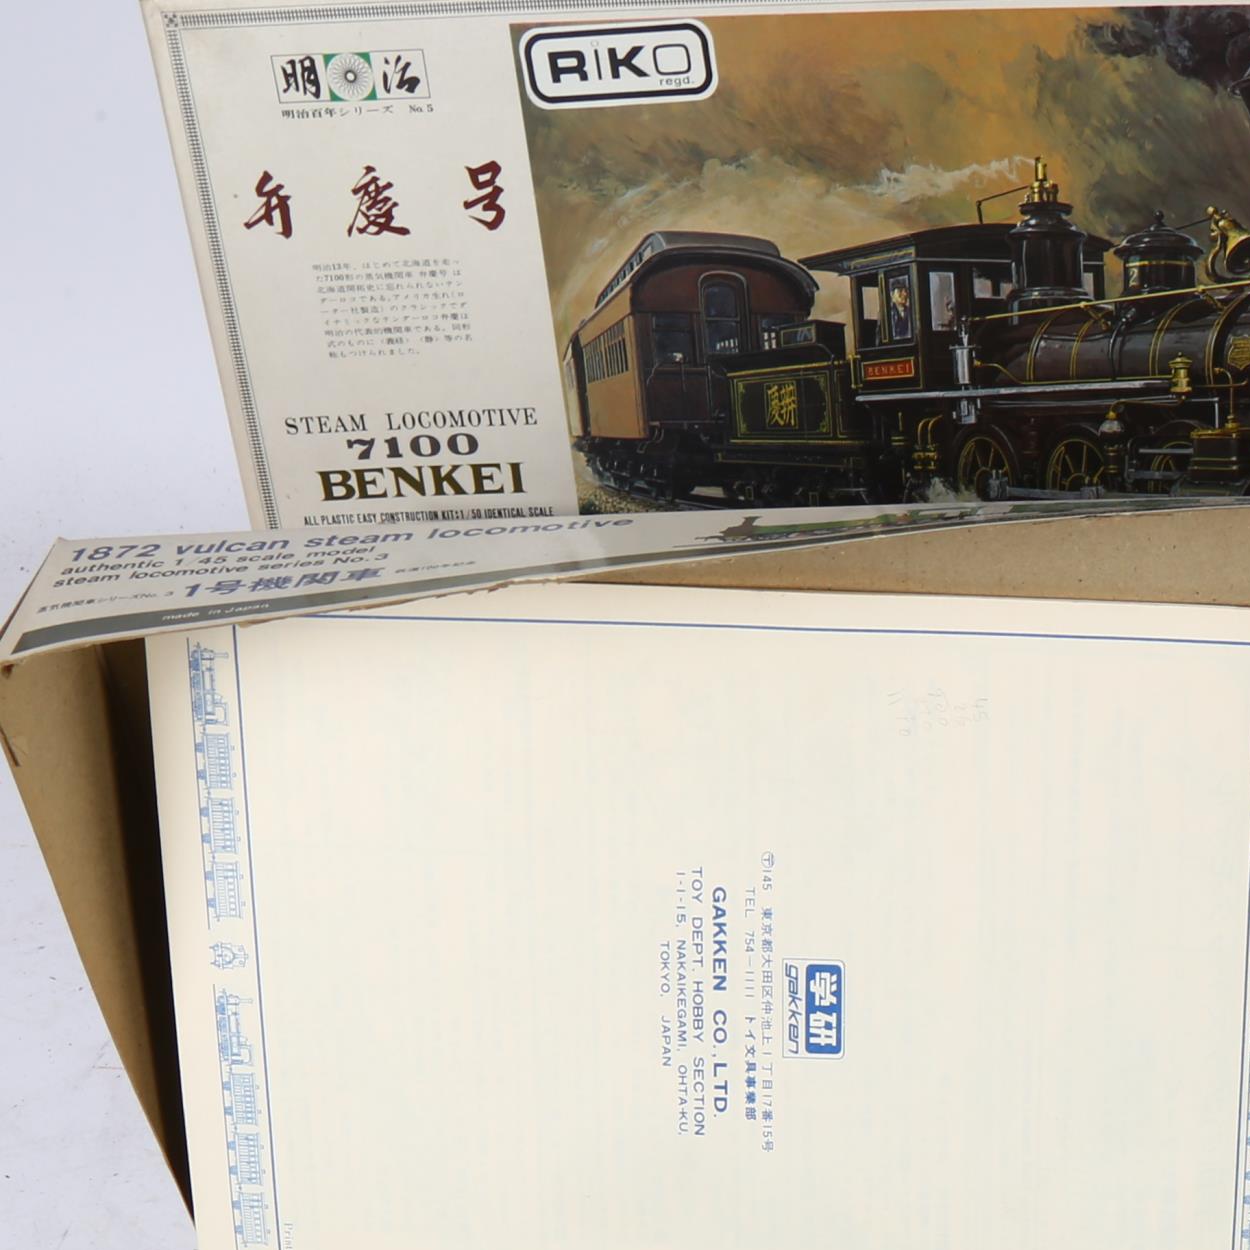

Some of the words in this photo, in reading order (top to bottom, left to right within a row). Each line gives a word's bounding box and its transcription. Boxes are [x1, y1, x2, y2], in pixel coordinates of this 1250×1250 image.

[285, 414, 368, 435] STEAM
[387, 407, 538, 431] LOCOMOTIVE
[346, 432, 479, 460] 7100
[316, 462, 528, 501] BENKEI
[304, 515, 319, 526] ALL
[321, 514, 354, 525] PLASTIC
[357, 512, 377, 524] EASY
[380, 510, 439, 523] CONSTRUCTION
[484, 507, 525, 519] IDENTICAL
[528, 506, 554, 518] SCALE
[72, 544, 161, 562] 1872
[176, 539, 291, 556] vulcan
[304, 530, 414, 548] steam
[427, 517, 635, 539] locomotive
[52, 572, 121, 588] steam
[129, 563, 254, 581] locomotive
[259, 558, 325, 571] series
[61, 557, 165, 576] authentic
[235, 550, 295, 563] scale
[306, 546, 376, 558] model
[185, 567, 387, 597] 1号機関車
[691, 866, 703, 903] TOY
[744, 887, 756, 918] TEL
[691, 917, 704, 972] DEPT.
[712, 886, 728, 991] GAKKEN
[692, 981, 704, 1043] HOBBY
[784, 962, 803, 1054] gakken
[808, 972, 838, 1046] 学研
[661, 1016, 672, 1067] JAPAN
[693, 1056, 706, 1136] SECTION
